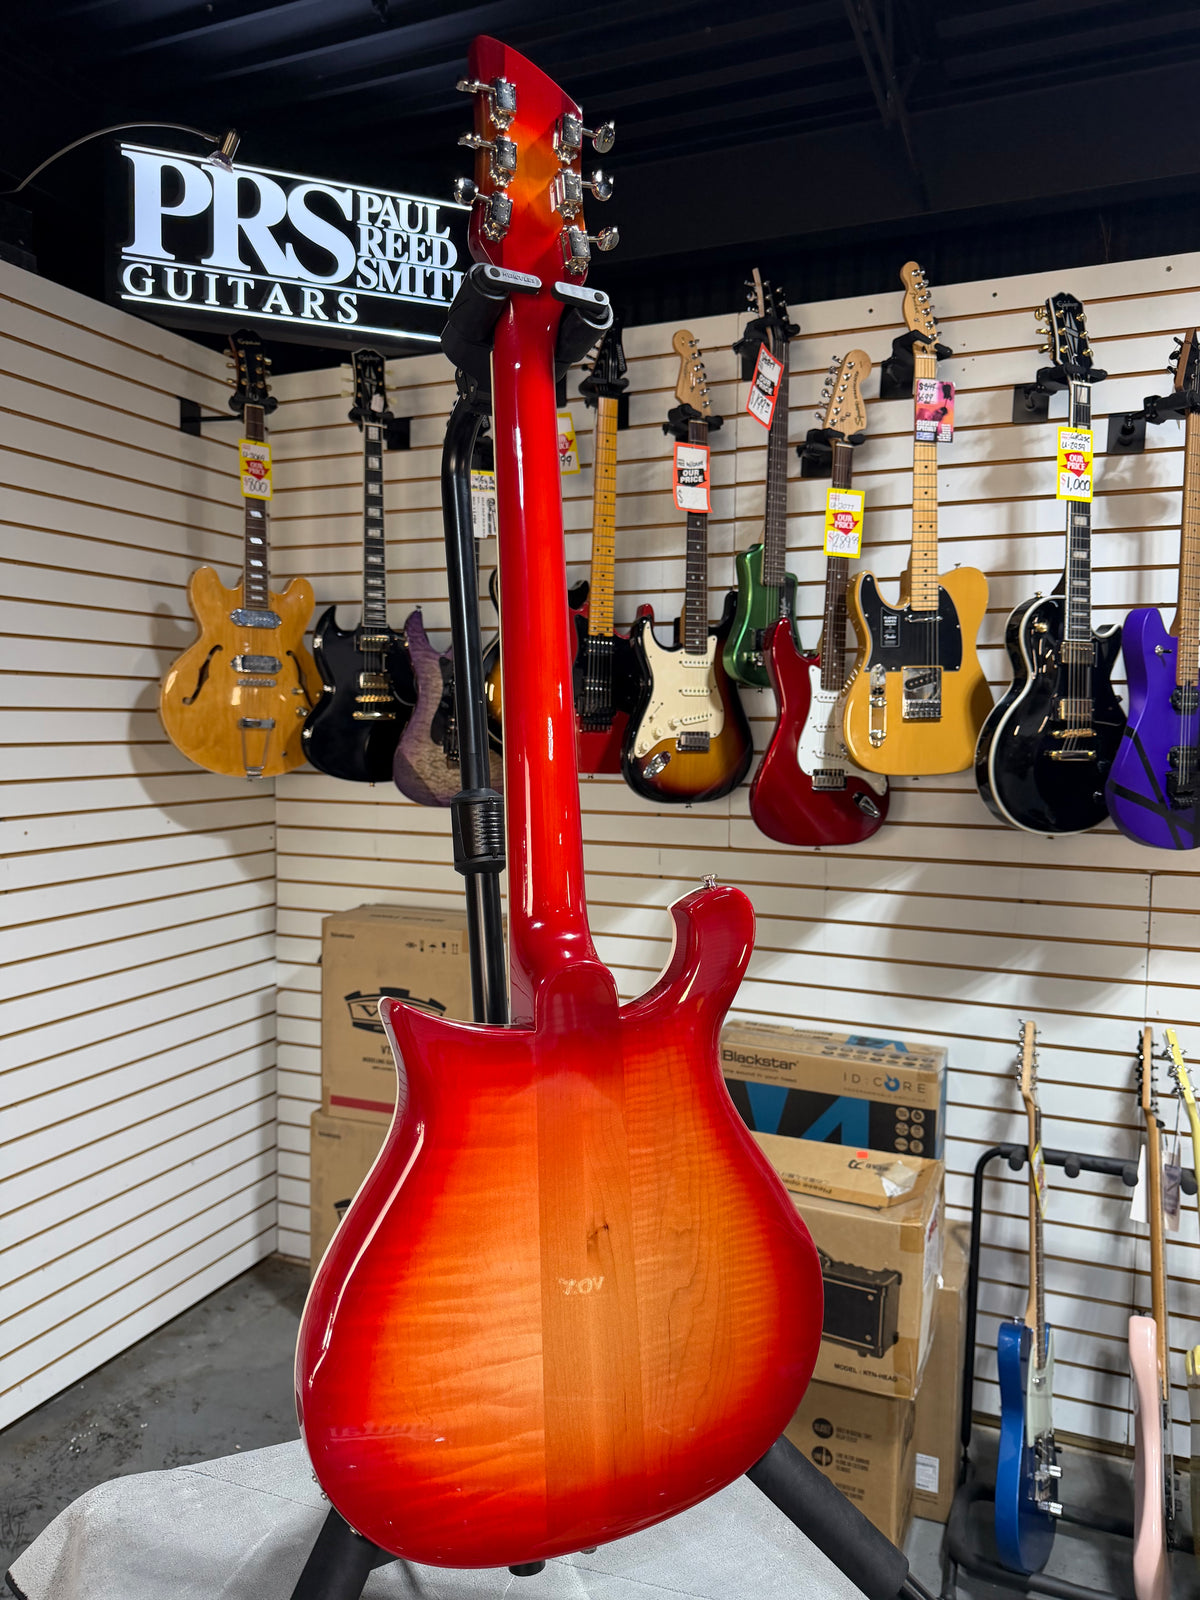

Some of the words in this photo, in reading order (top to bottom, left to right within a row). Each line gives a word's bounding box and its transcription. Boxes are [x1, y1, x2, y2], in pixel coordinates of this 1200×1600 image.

[121, 149, 358, 285] PRS
[356, 190, 451, 239] PAUL
[356, 224, 459, 267] REED
[122, 262, 359, 325] GUITARS
[1068, 454, 1084, 463] OUR
[1067, 461, 1086, 471] PRICE
[682, 469, 700, 477] OUR
[679, 476, 704, 484] PRICE
[1061, 474, 1091, 492] $1,000
[836, 513, 853, 522] OUR
[834, 520, 855, 530] PRICE
[722, 1049, 797, 1072] Blackstar
[833, 1363, 858, 1375] MODEL
